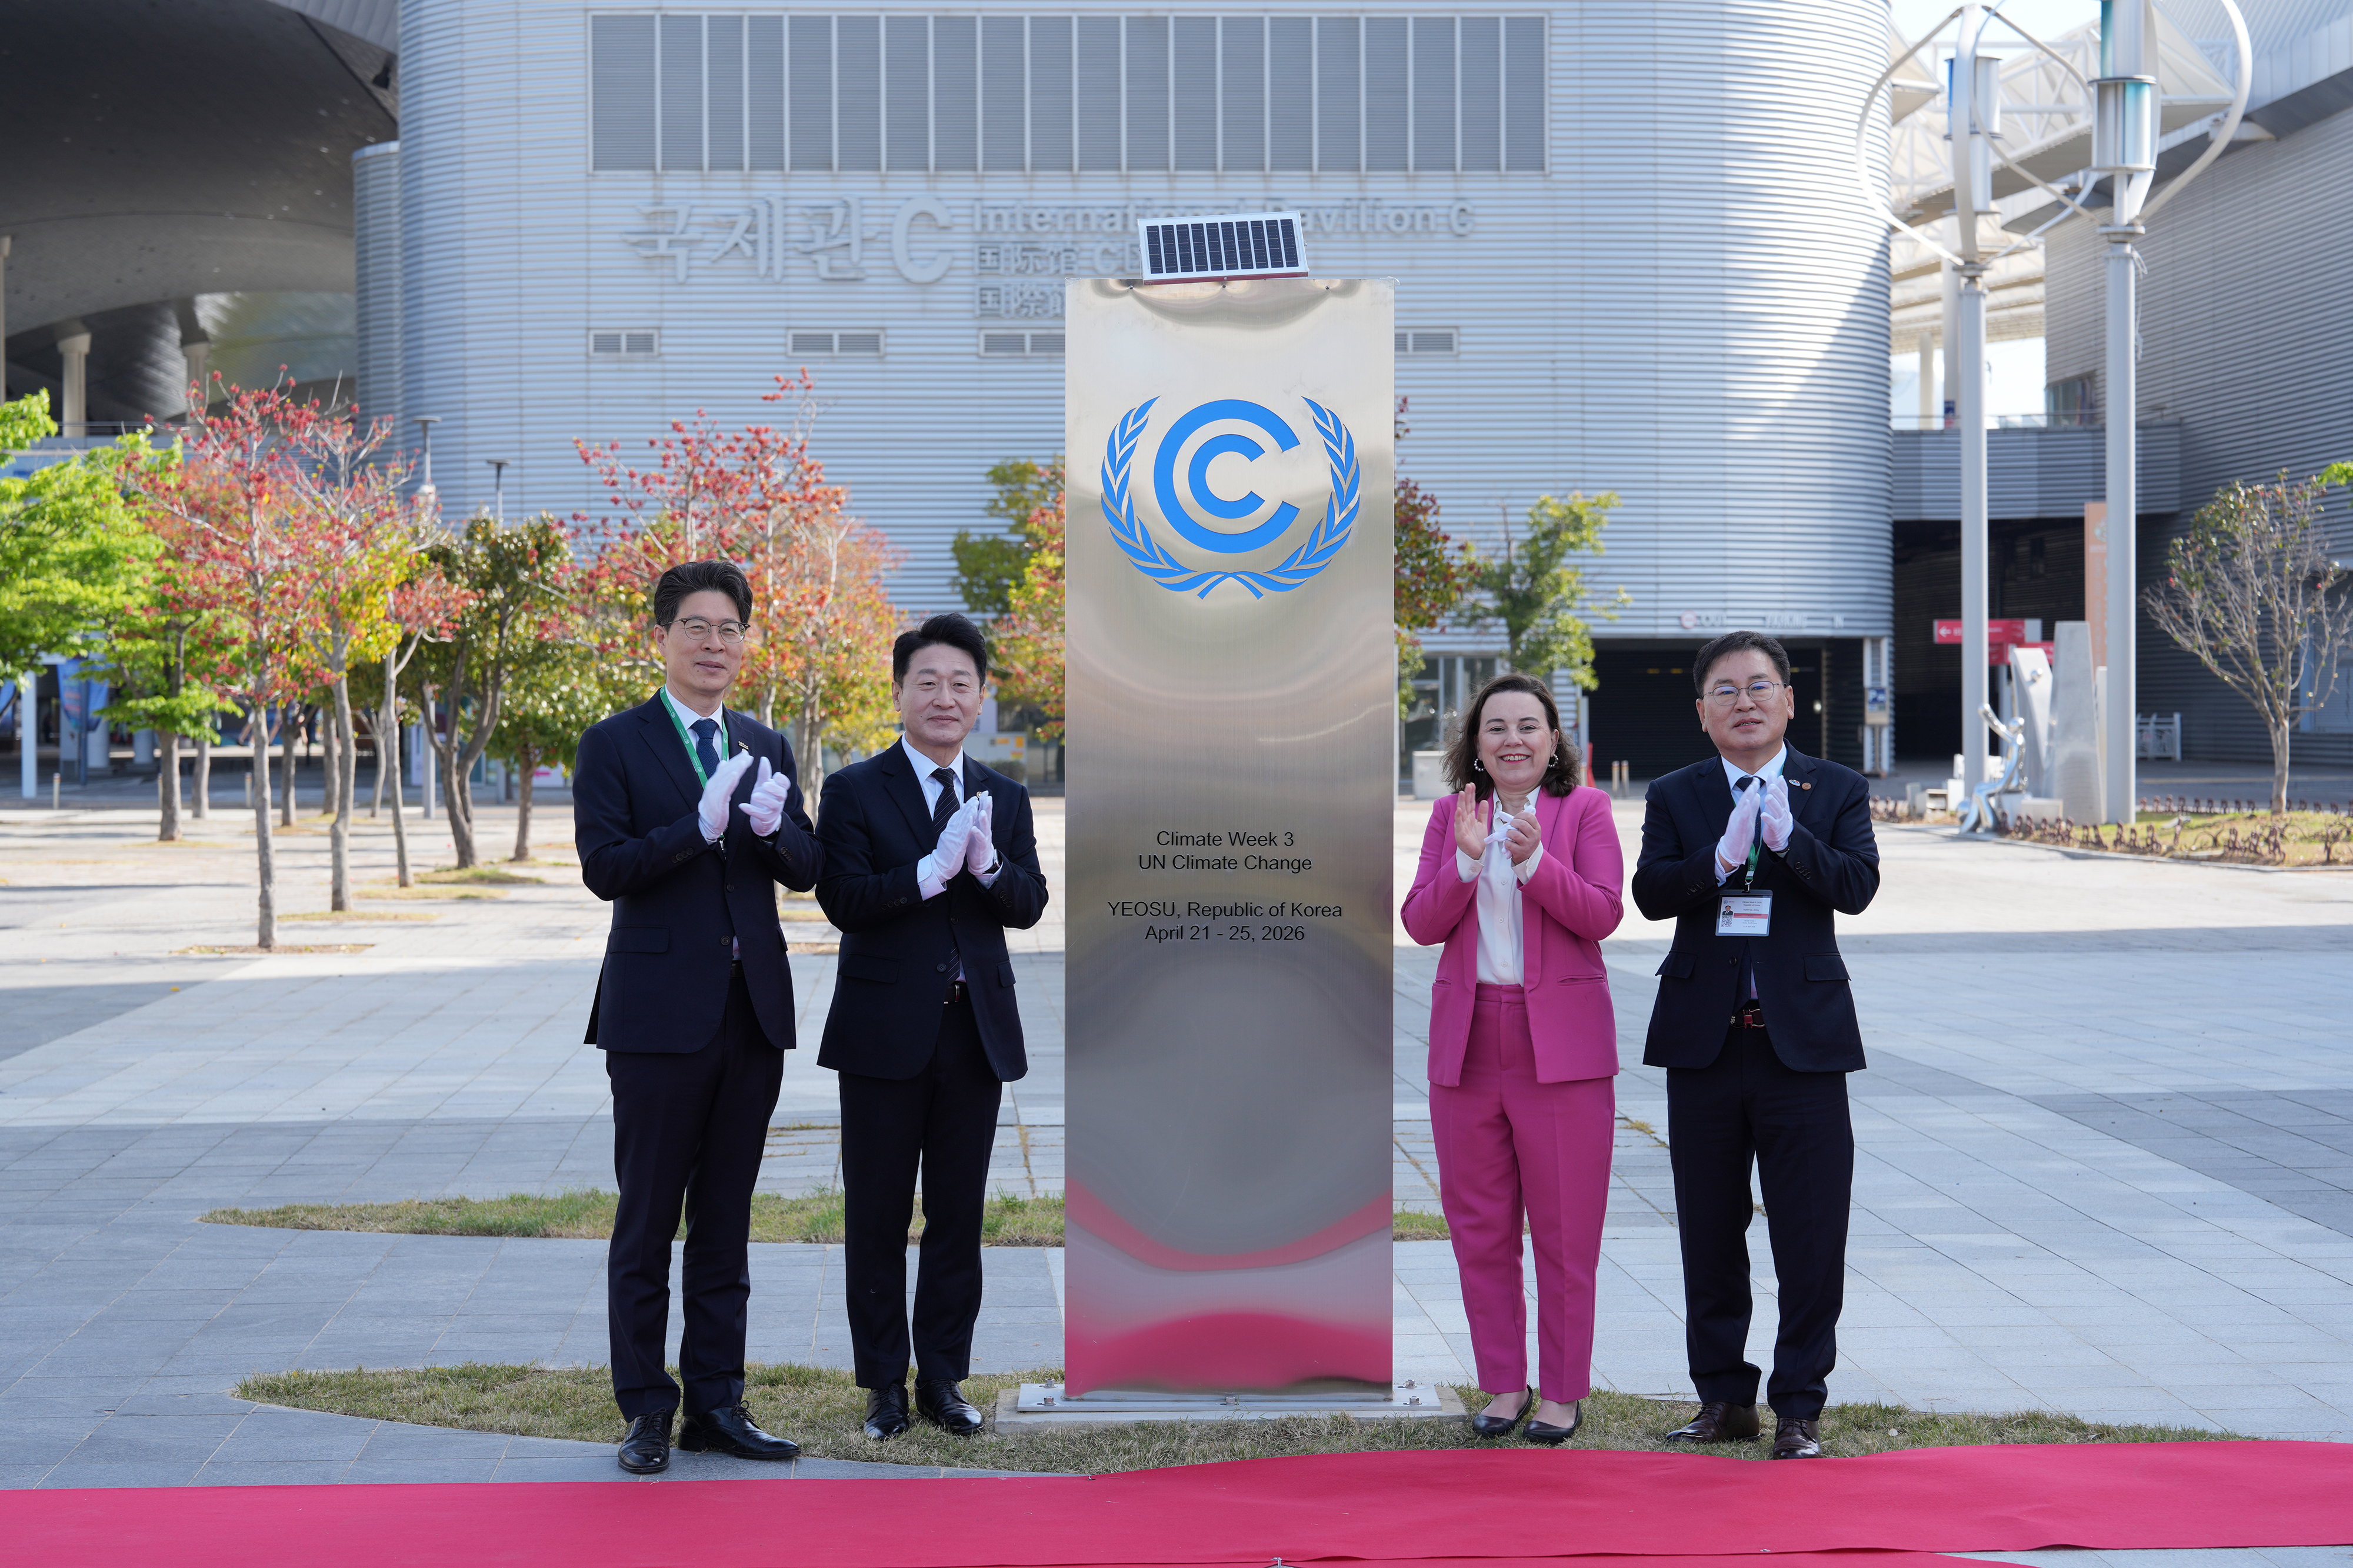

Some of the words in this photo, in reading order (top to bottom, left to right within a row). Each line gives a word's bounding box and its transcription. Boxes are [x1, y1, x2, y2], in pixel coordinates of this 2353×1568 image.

[1449, 200, 1475, 235] C
[621, 195, 881, 285] 국제관
[891, 196, 954, 285] C
[1156, 830, 1222, 847] Climate
[1228, 831, 1278, 847] Week
[1284, 832, 1294, 847] 3
[1139, 855, 1165, 870] UN
[1172, 855, 1238, 870] Climate
[1244, 855, 1312, 874] Change
[1107, 901, 1181, 920] YEOSU,
[1188, 901, 1264, 920] Republic
[1269, 902, 1286, 918] of
[1291, 902, 1342, 918] Korea
[1145, 925, 1183, 944] April
[1189, 926, 1209, 940] 21
[1229, 926, 1255, 943] 25,
[1262, 926, 1305, 940] 2026
